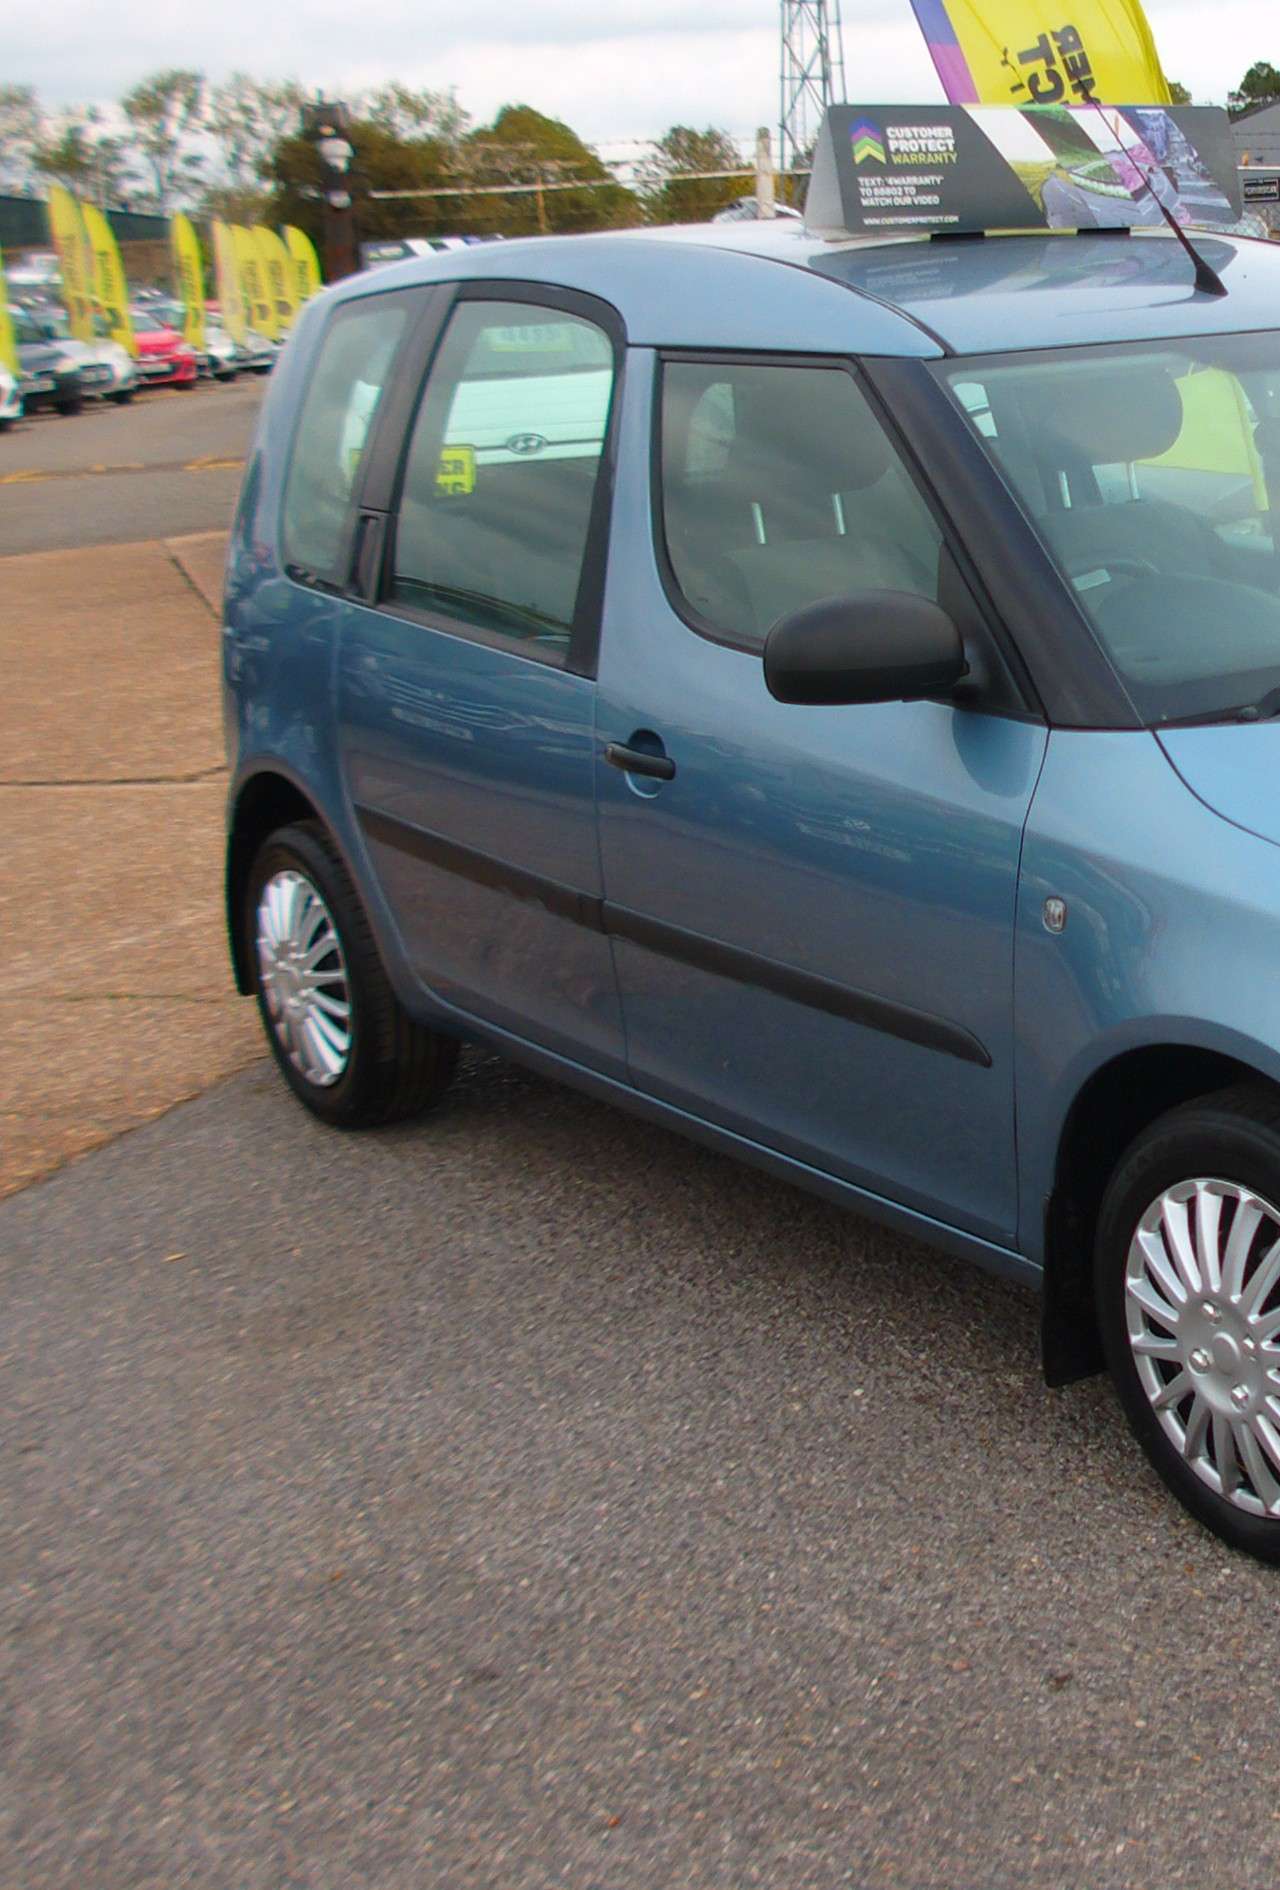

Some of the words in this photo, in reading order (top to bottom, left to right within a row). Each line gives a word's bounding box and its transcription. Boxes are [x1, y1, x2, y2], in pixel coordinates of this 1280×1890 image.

[886, 127, 953, 138] CUSTOMER
[888, 140, 955, 153] PROTECT
[891, 152, 957, 165] WARRANTY
